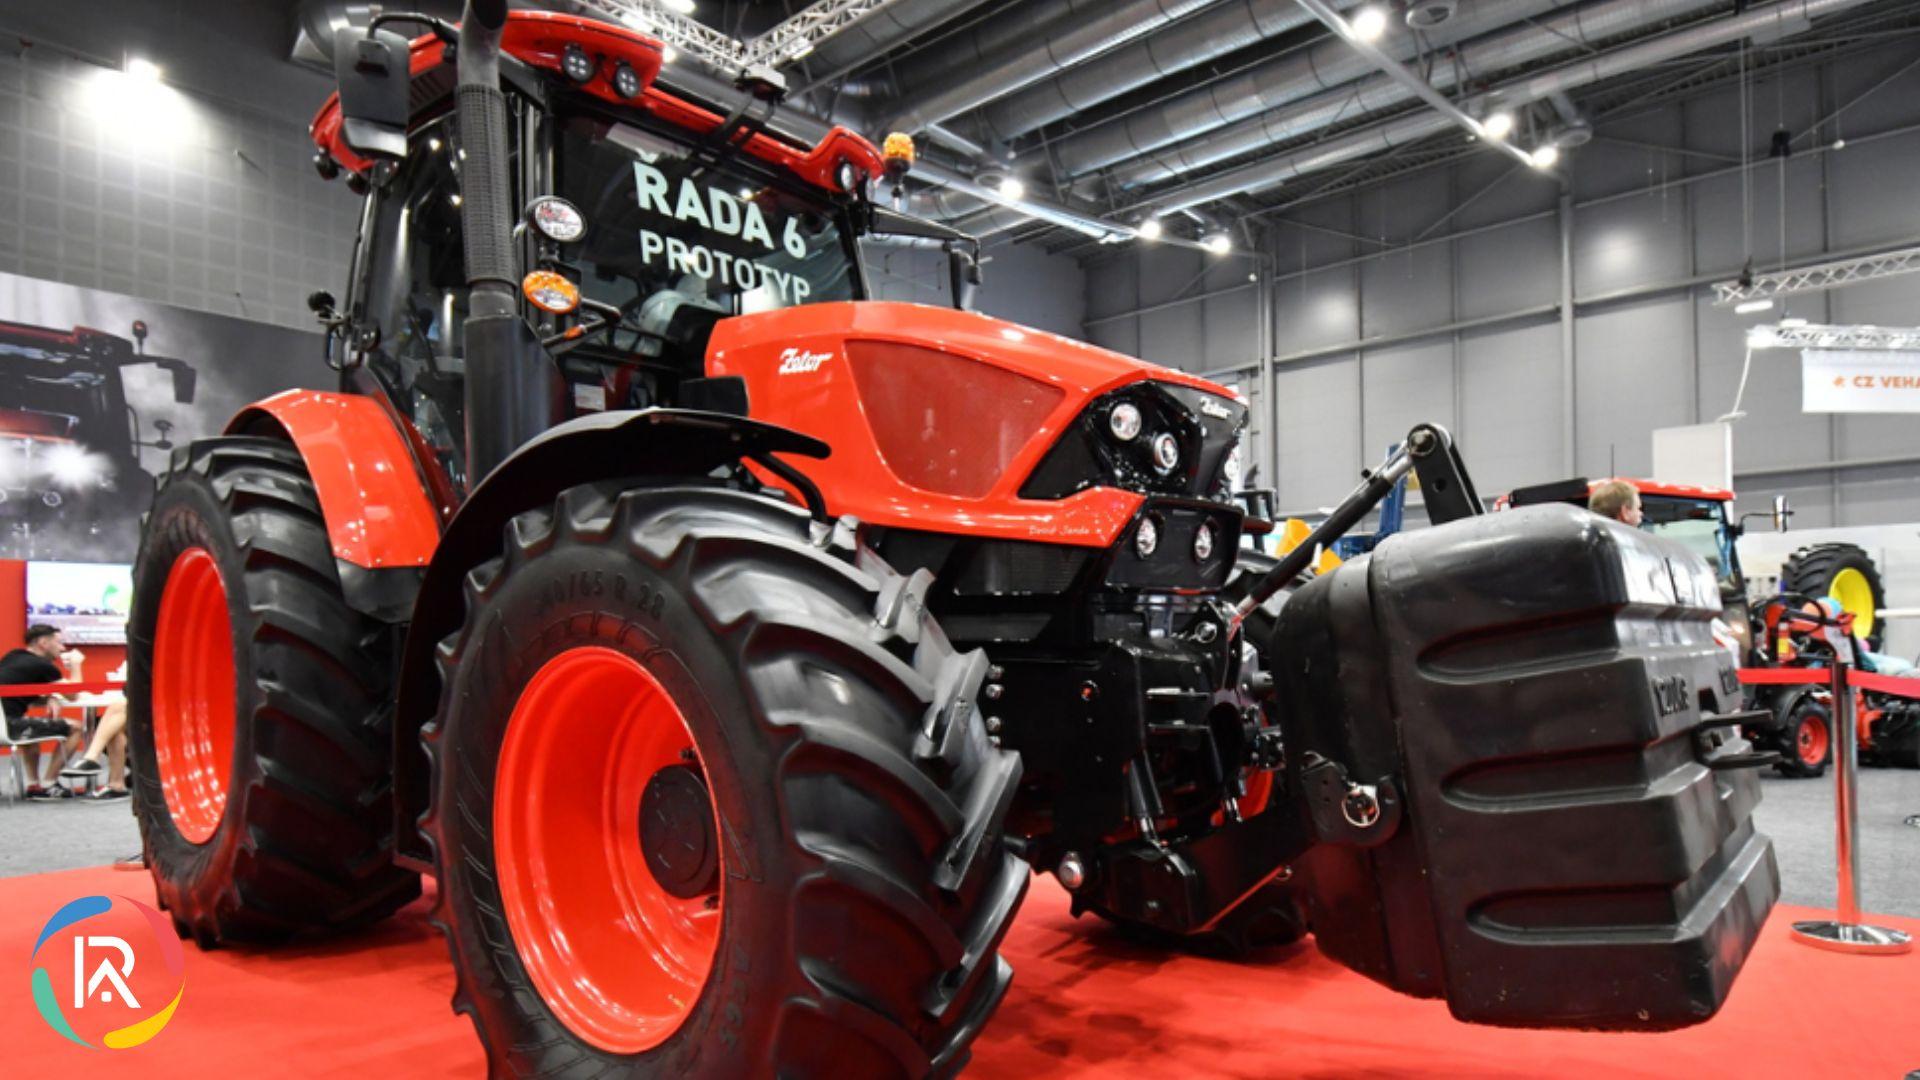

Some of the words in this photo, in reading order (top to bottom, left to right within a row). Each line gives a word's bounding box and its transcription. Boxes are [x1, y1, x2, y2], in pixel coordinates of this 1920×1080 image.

[633, 148, 774, 249] ŘADA
[783, 217, 806, 259] 6
[640, 229, 811, 306] PROTOTYP
[1853, 375, 1875, 389] CZ
